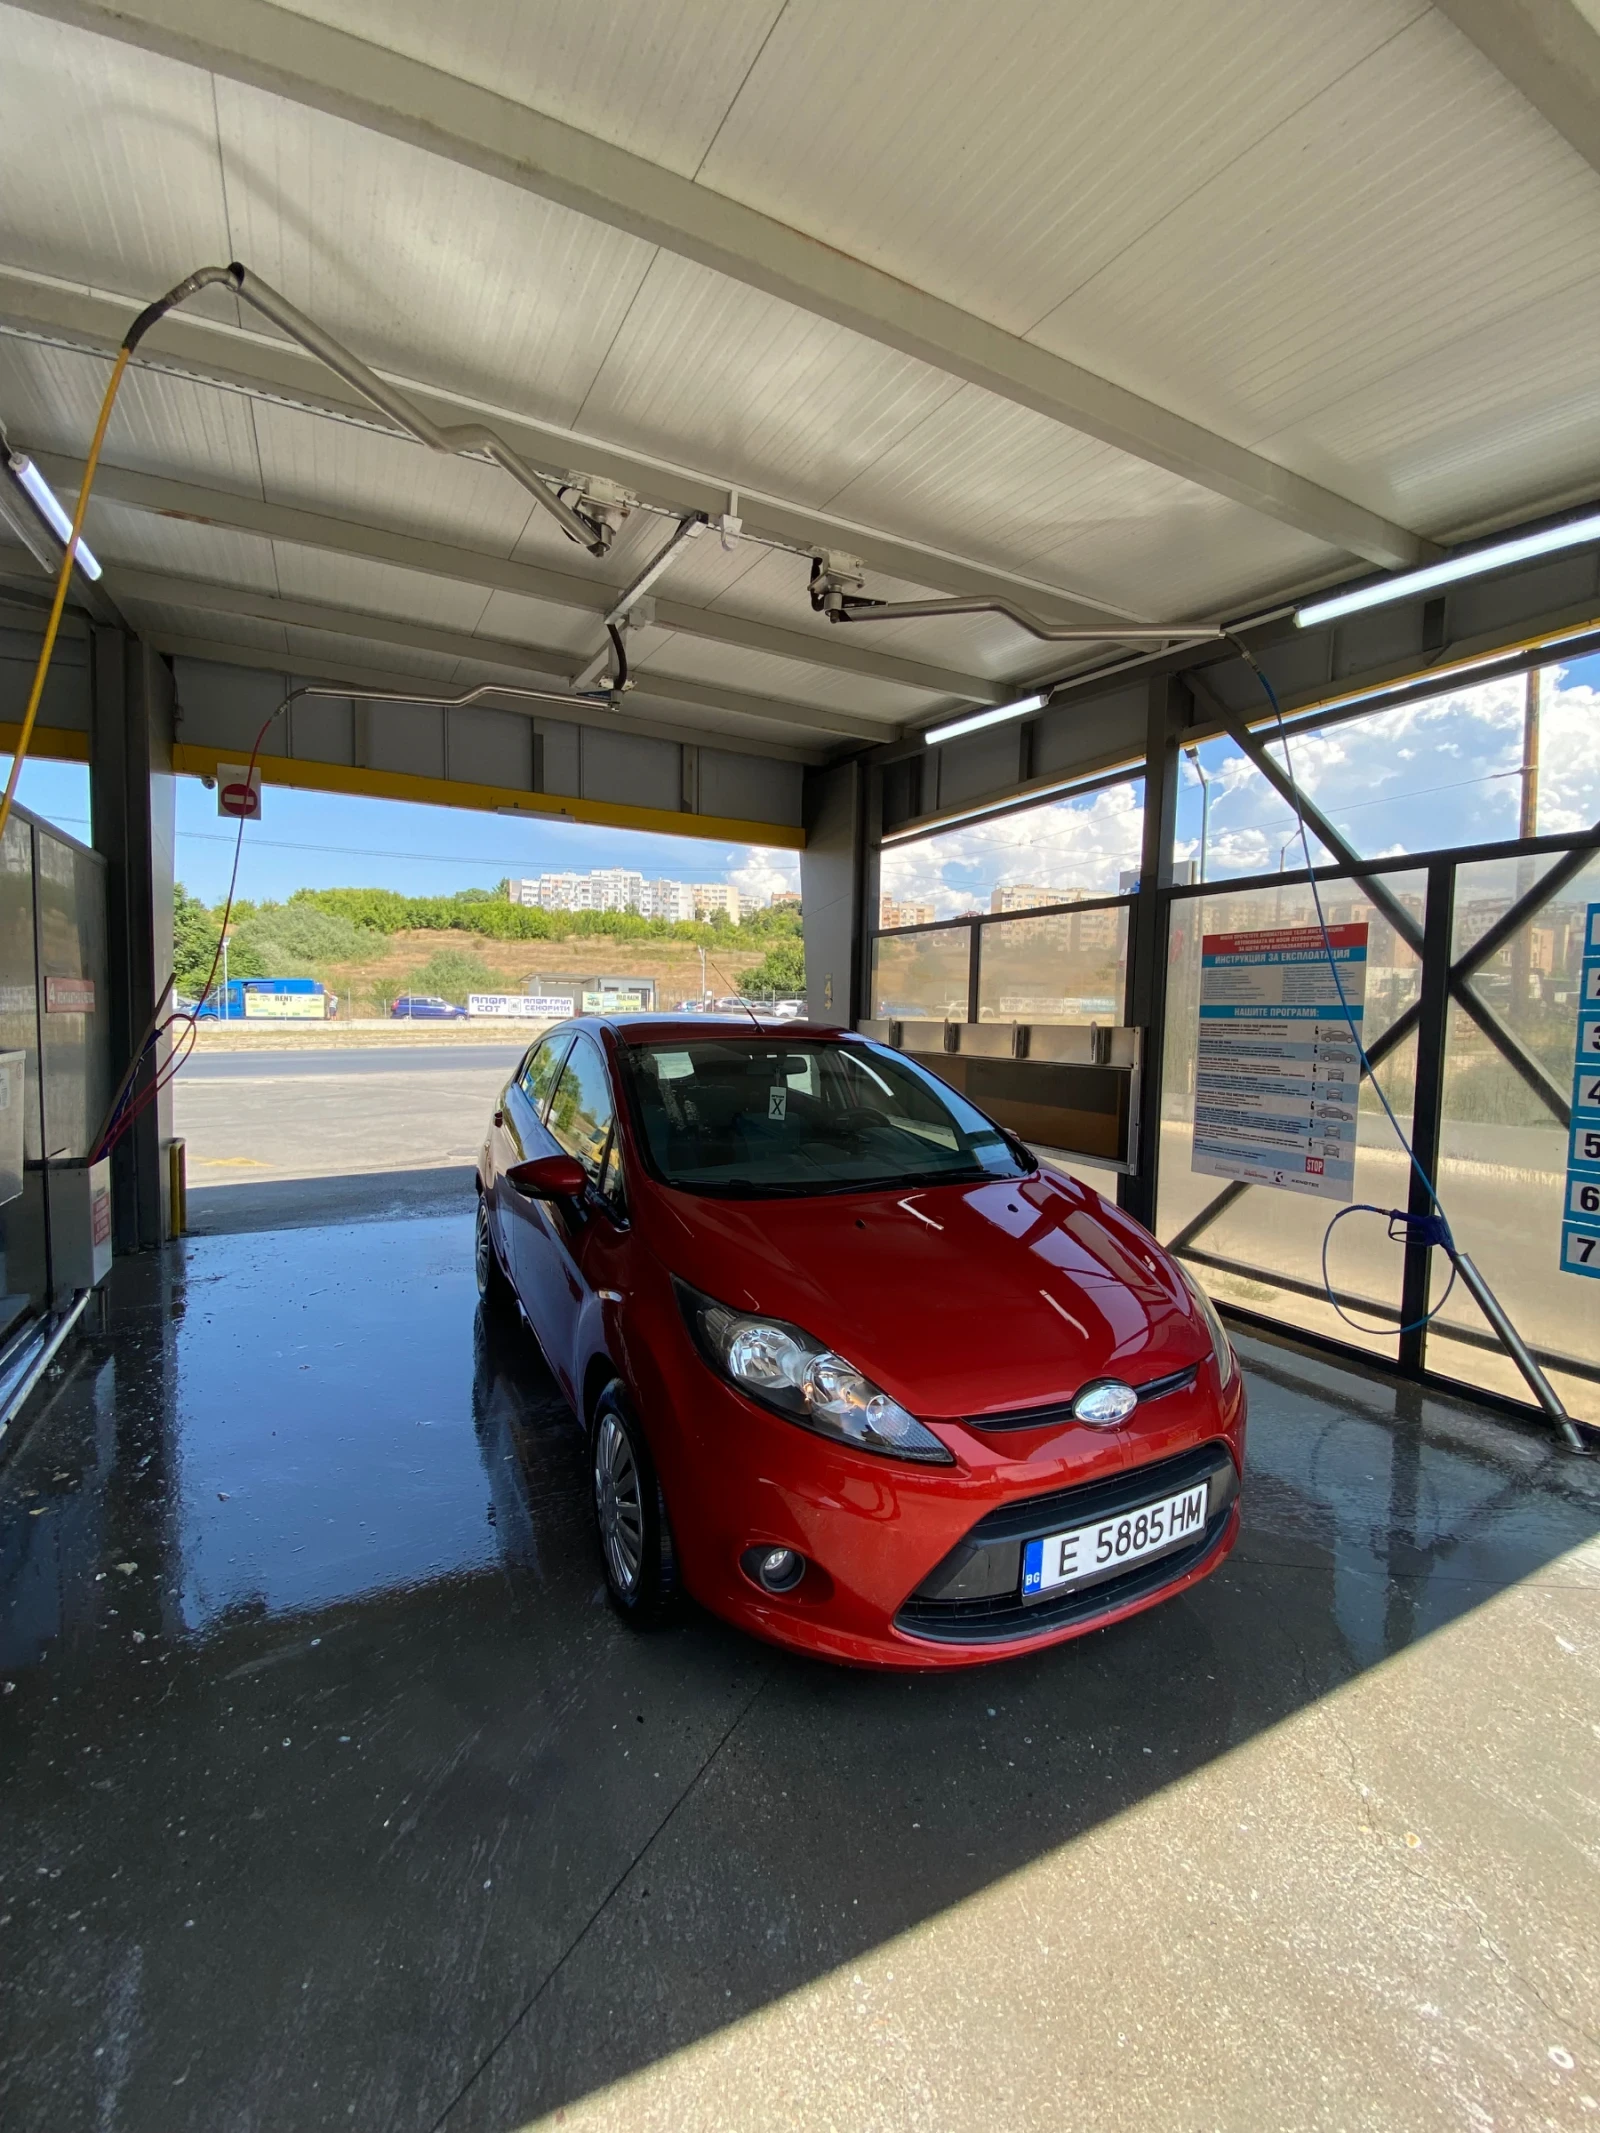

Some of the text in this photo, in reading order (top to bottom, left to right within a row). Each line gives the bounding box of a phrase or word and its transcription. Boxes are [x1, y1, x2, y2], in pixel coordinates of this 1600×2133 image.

[1215, 948, 1350, 964] ИНСТРУКЦИЯ ЗА ЕКСПЛОАТАЦИЯ
[1234, 1007, 1319, 1018] НАШИТЕ ПРОГРАМИ:
[1584, 1133, 1600, 1158] 5
[1307, 1158, 1323, 1172] STOP
[1580, 1186, 1600, 1212] 6
[1577, 1237, 1596, 1262] 7
[1059, 1490, 1203, 1577] E 5885 HM
[1025, 1571, 1040, 1586] BG
